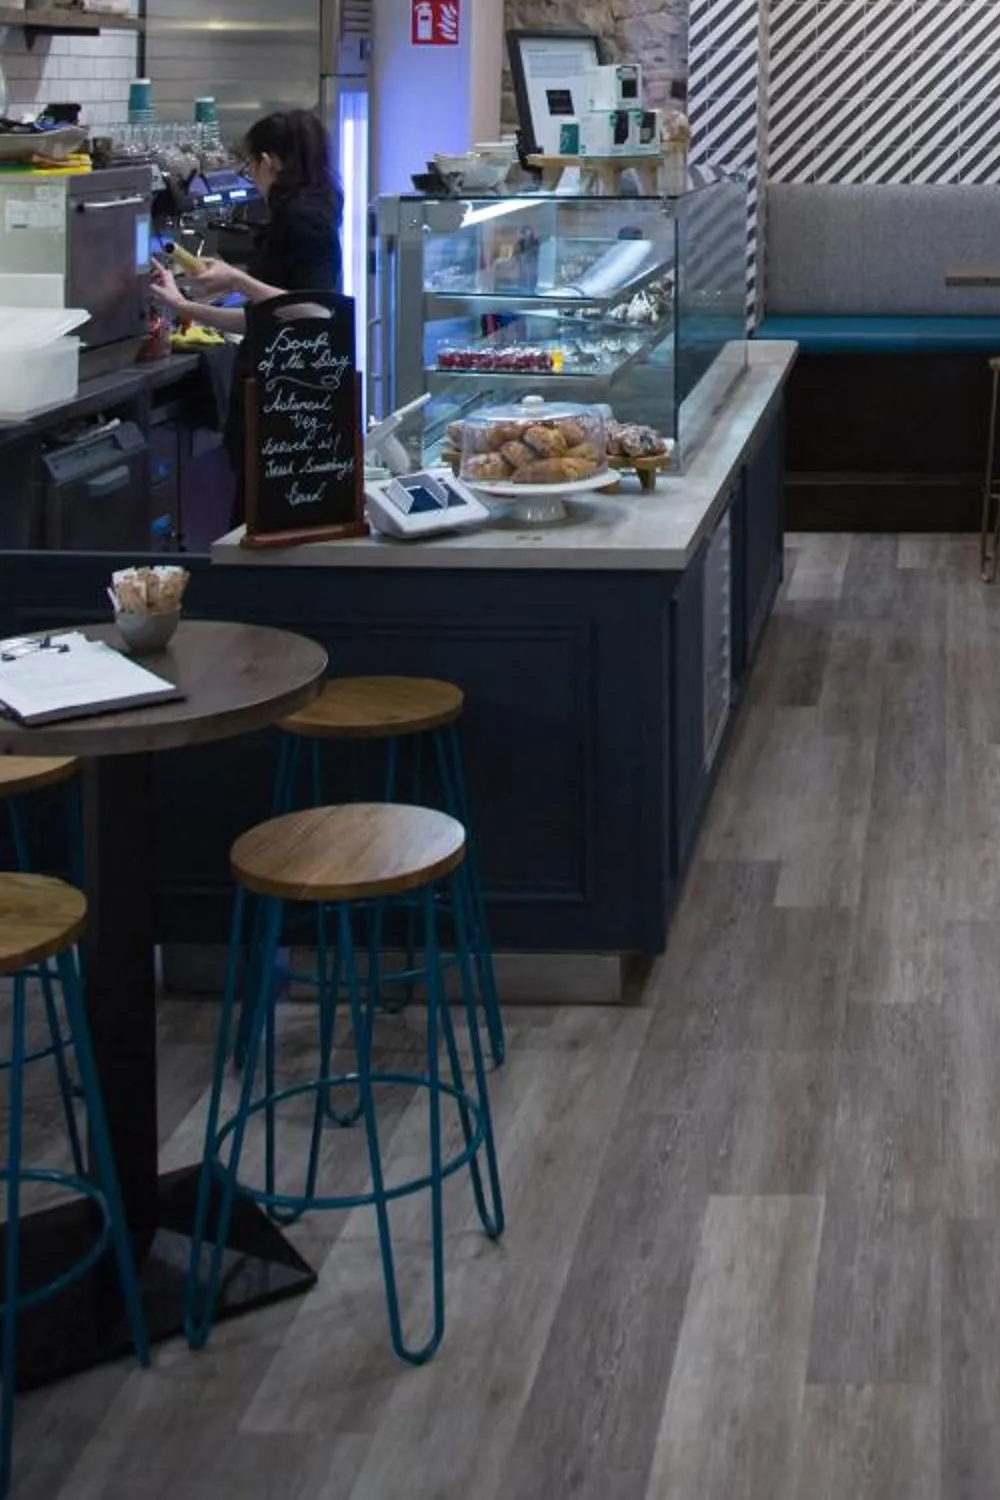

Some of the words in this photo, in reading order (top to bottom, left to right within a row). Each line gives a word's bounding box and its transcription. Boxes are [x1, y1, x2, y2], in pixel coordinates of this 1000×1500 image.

[265, 327, 329, 353] Soup
[257, 353, 275, 377] of
[280, 351, 305, 370] the
[309, 349, 352, 376] Day
